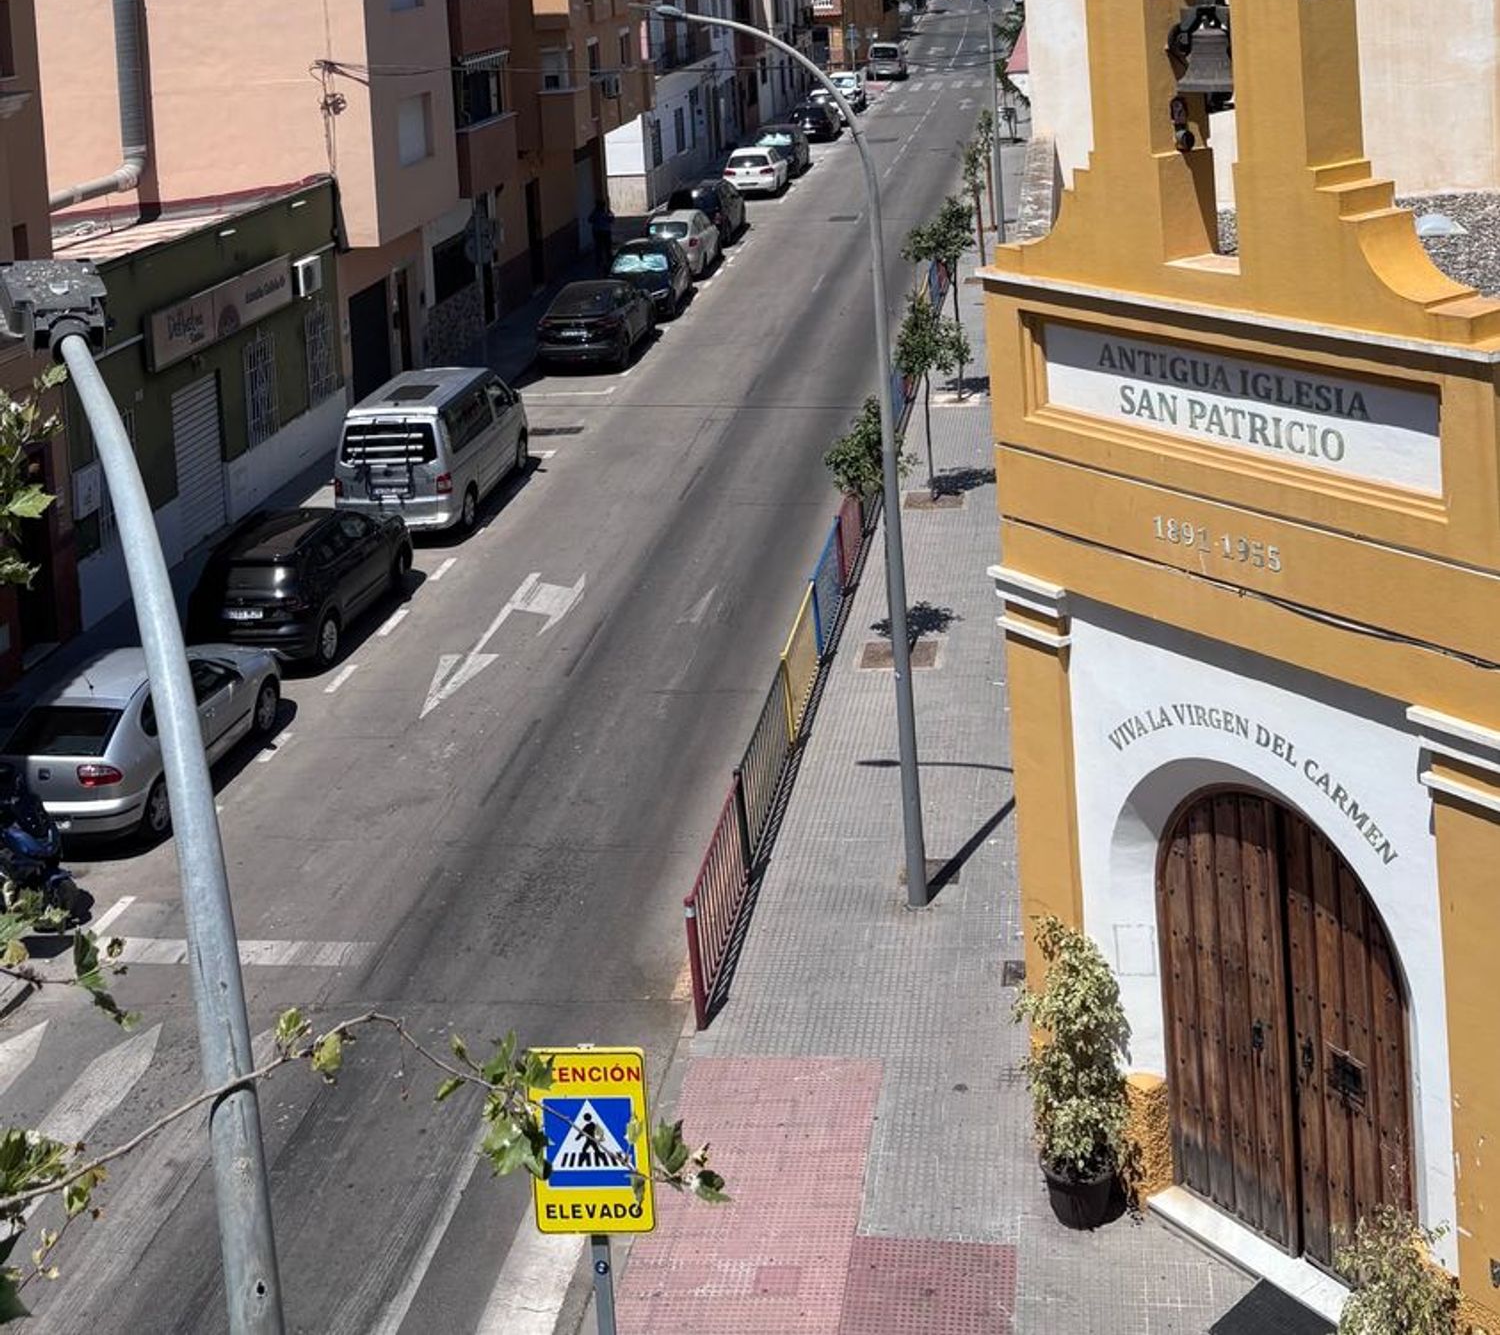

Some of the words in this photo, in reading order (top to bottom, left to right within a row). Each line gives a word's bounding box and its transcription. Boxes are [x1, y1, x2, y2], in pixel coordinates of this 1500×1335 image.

[1100, 343, 1231, 393] ANTIGUA
[1239, 369, 1371, 420] IGLESIA
[1120, 384, 1178, 425] SAN
[1187, 398, 1345, 462] PATRICIO
[1108, 715, 1149, 752] VIVA
[1148, 708, 1173, 732] LA
[1172, 703, 1250, 740] VIRGEN
[1255, 722, 1298, 769] DEL
[1302, 758, 1399, 867] CARMEN
[552, 1063, 641, 1083] ENCIÓN
[546, 1203, 643, 1220] ELEVADO
